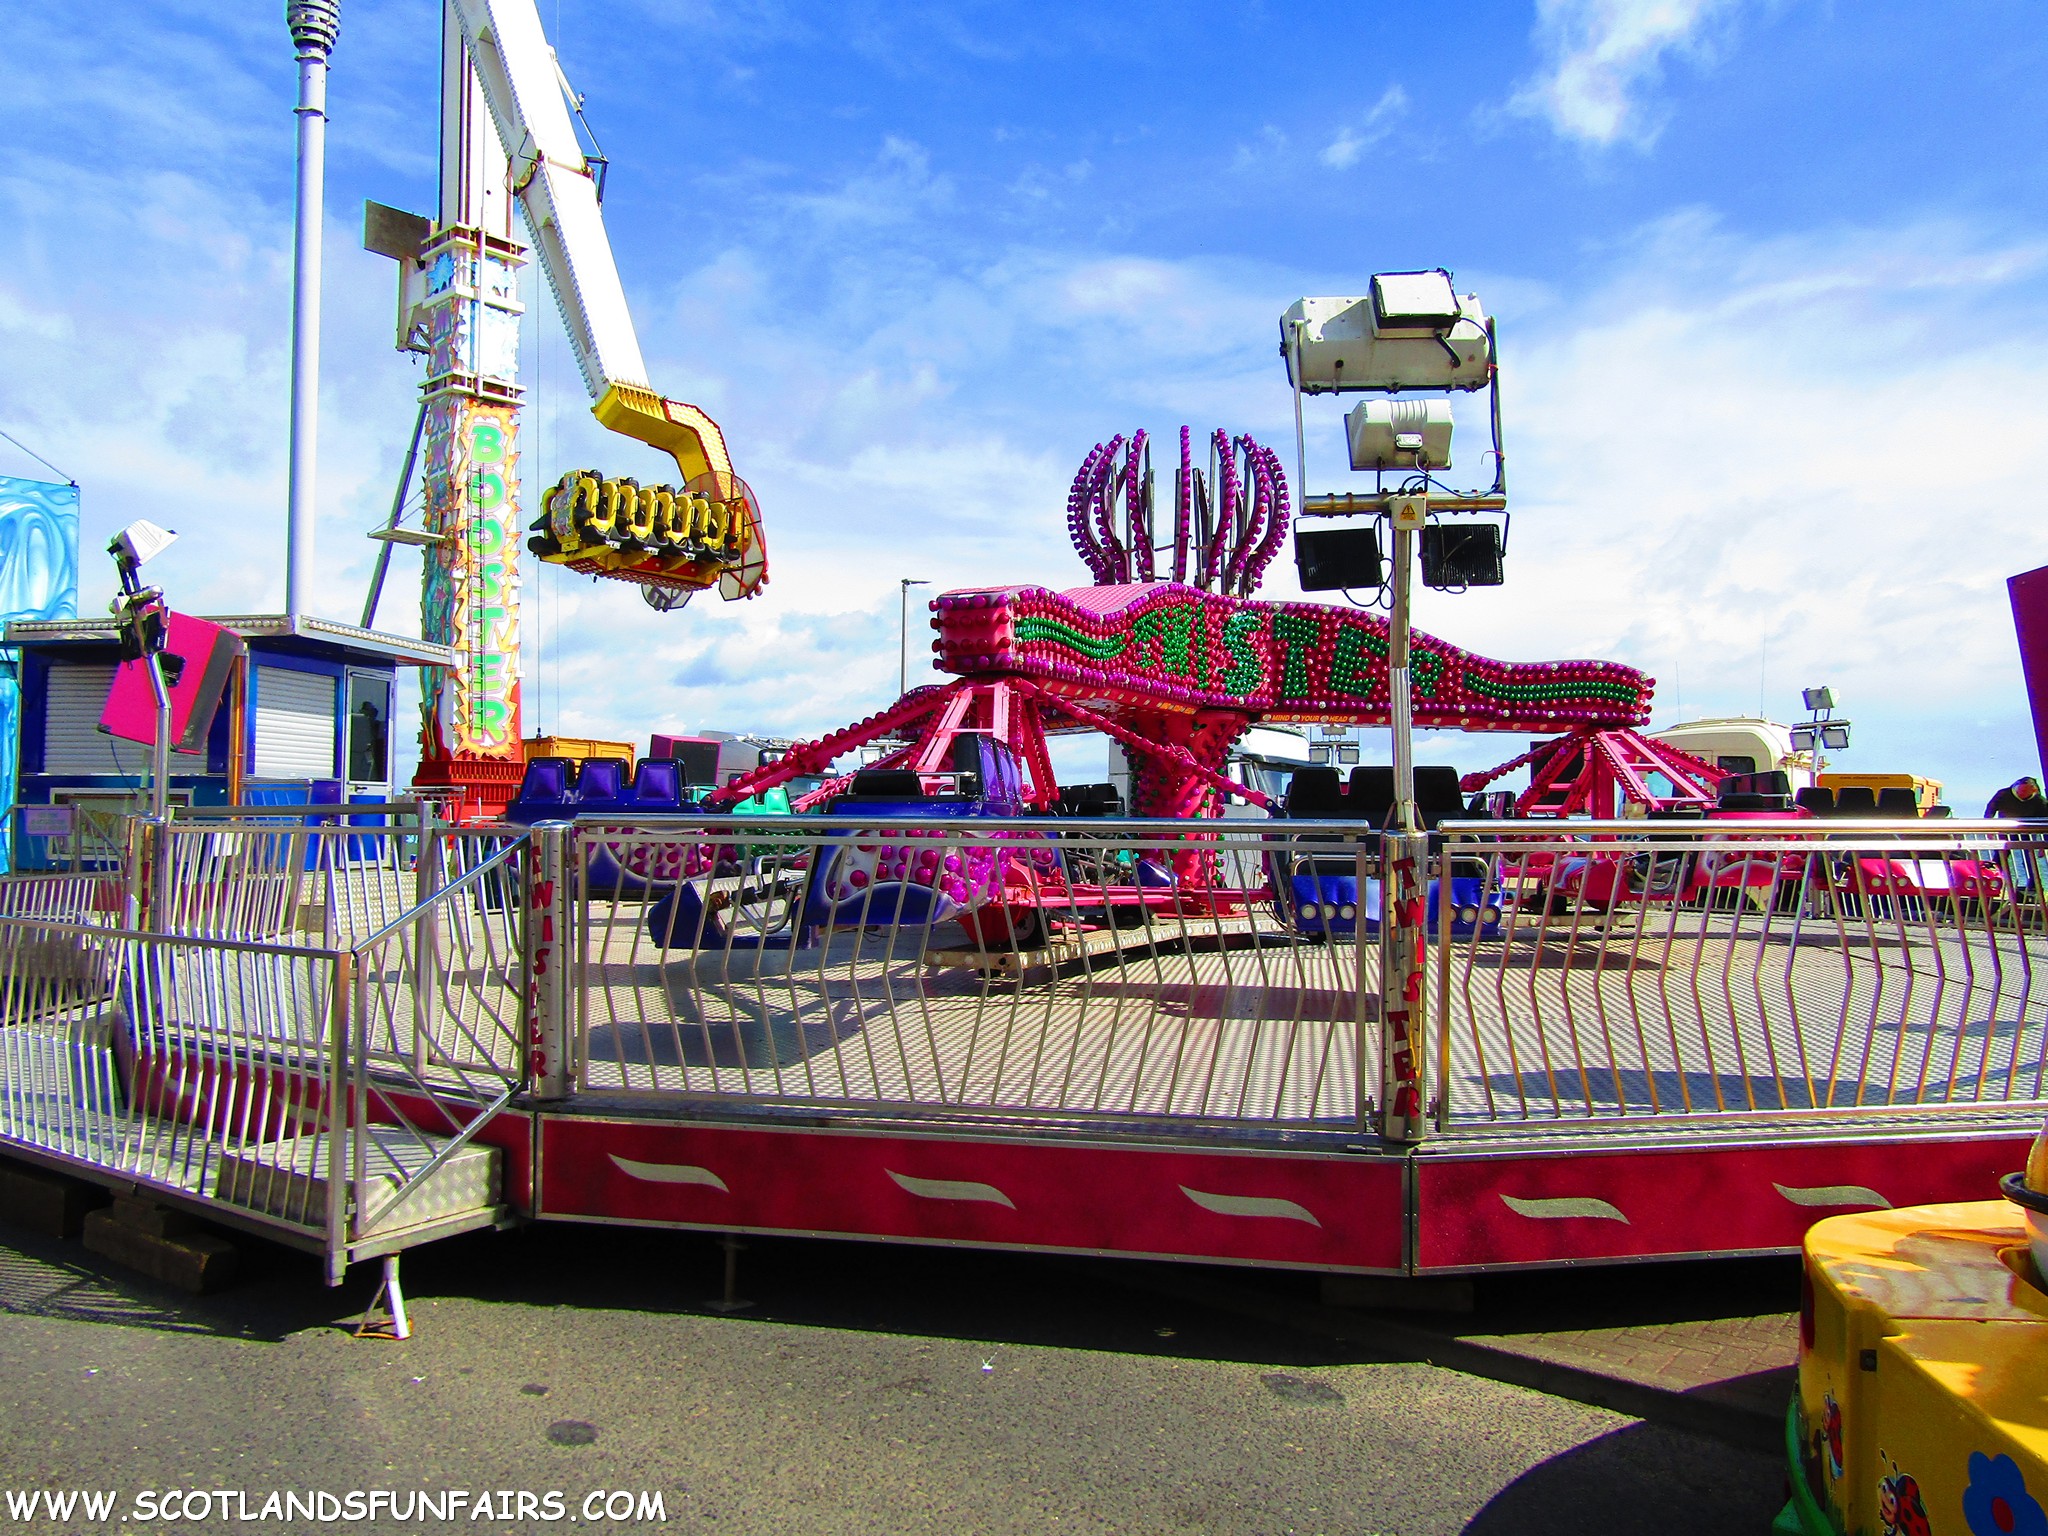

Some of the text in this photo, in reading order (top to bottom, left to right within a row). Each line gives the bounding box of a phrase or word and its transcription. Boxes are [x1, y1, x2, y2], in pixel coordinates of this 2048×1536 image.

[469, 421, 508, 746] BOOSTER
[1132, 602, 1445, 698] TWISTER
[1388, 856, 1426, 1117] TWISTER
